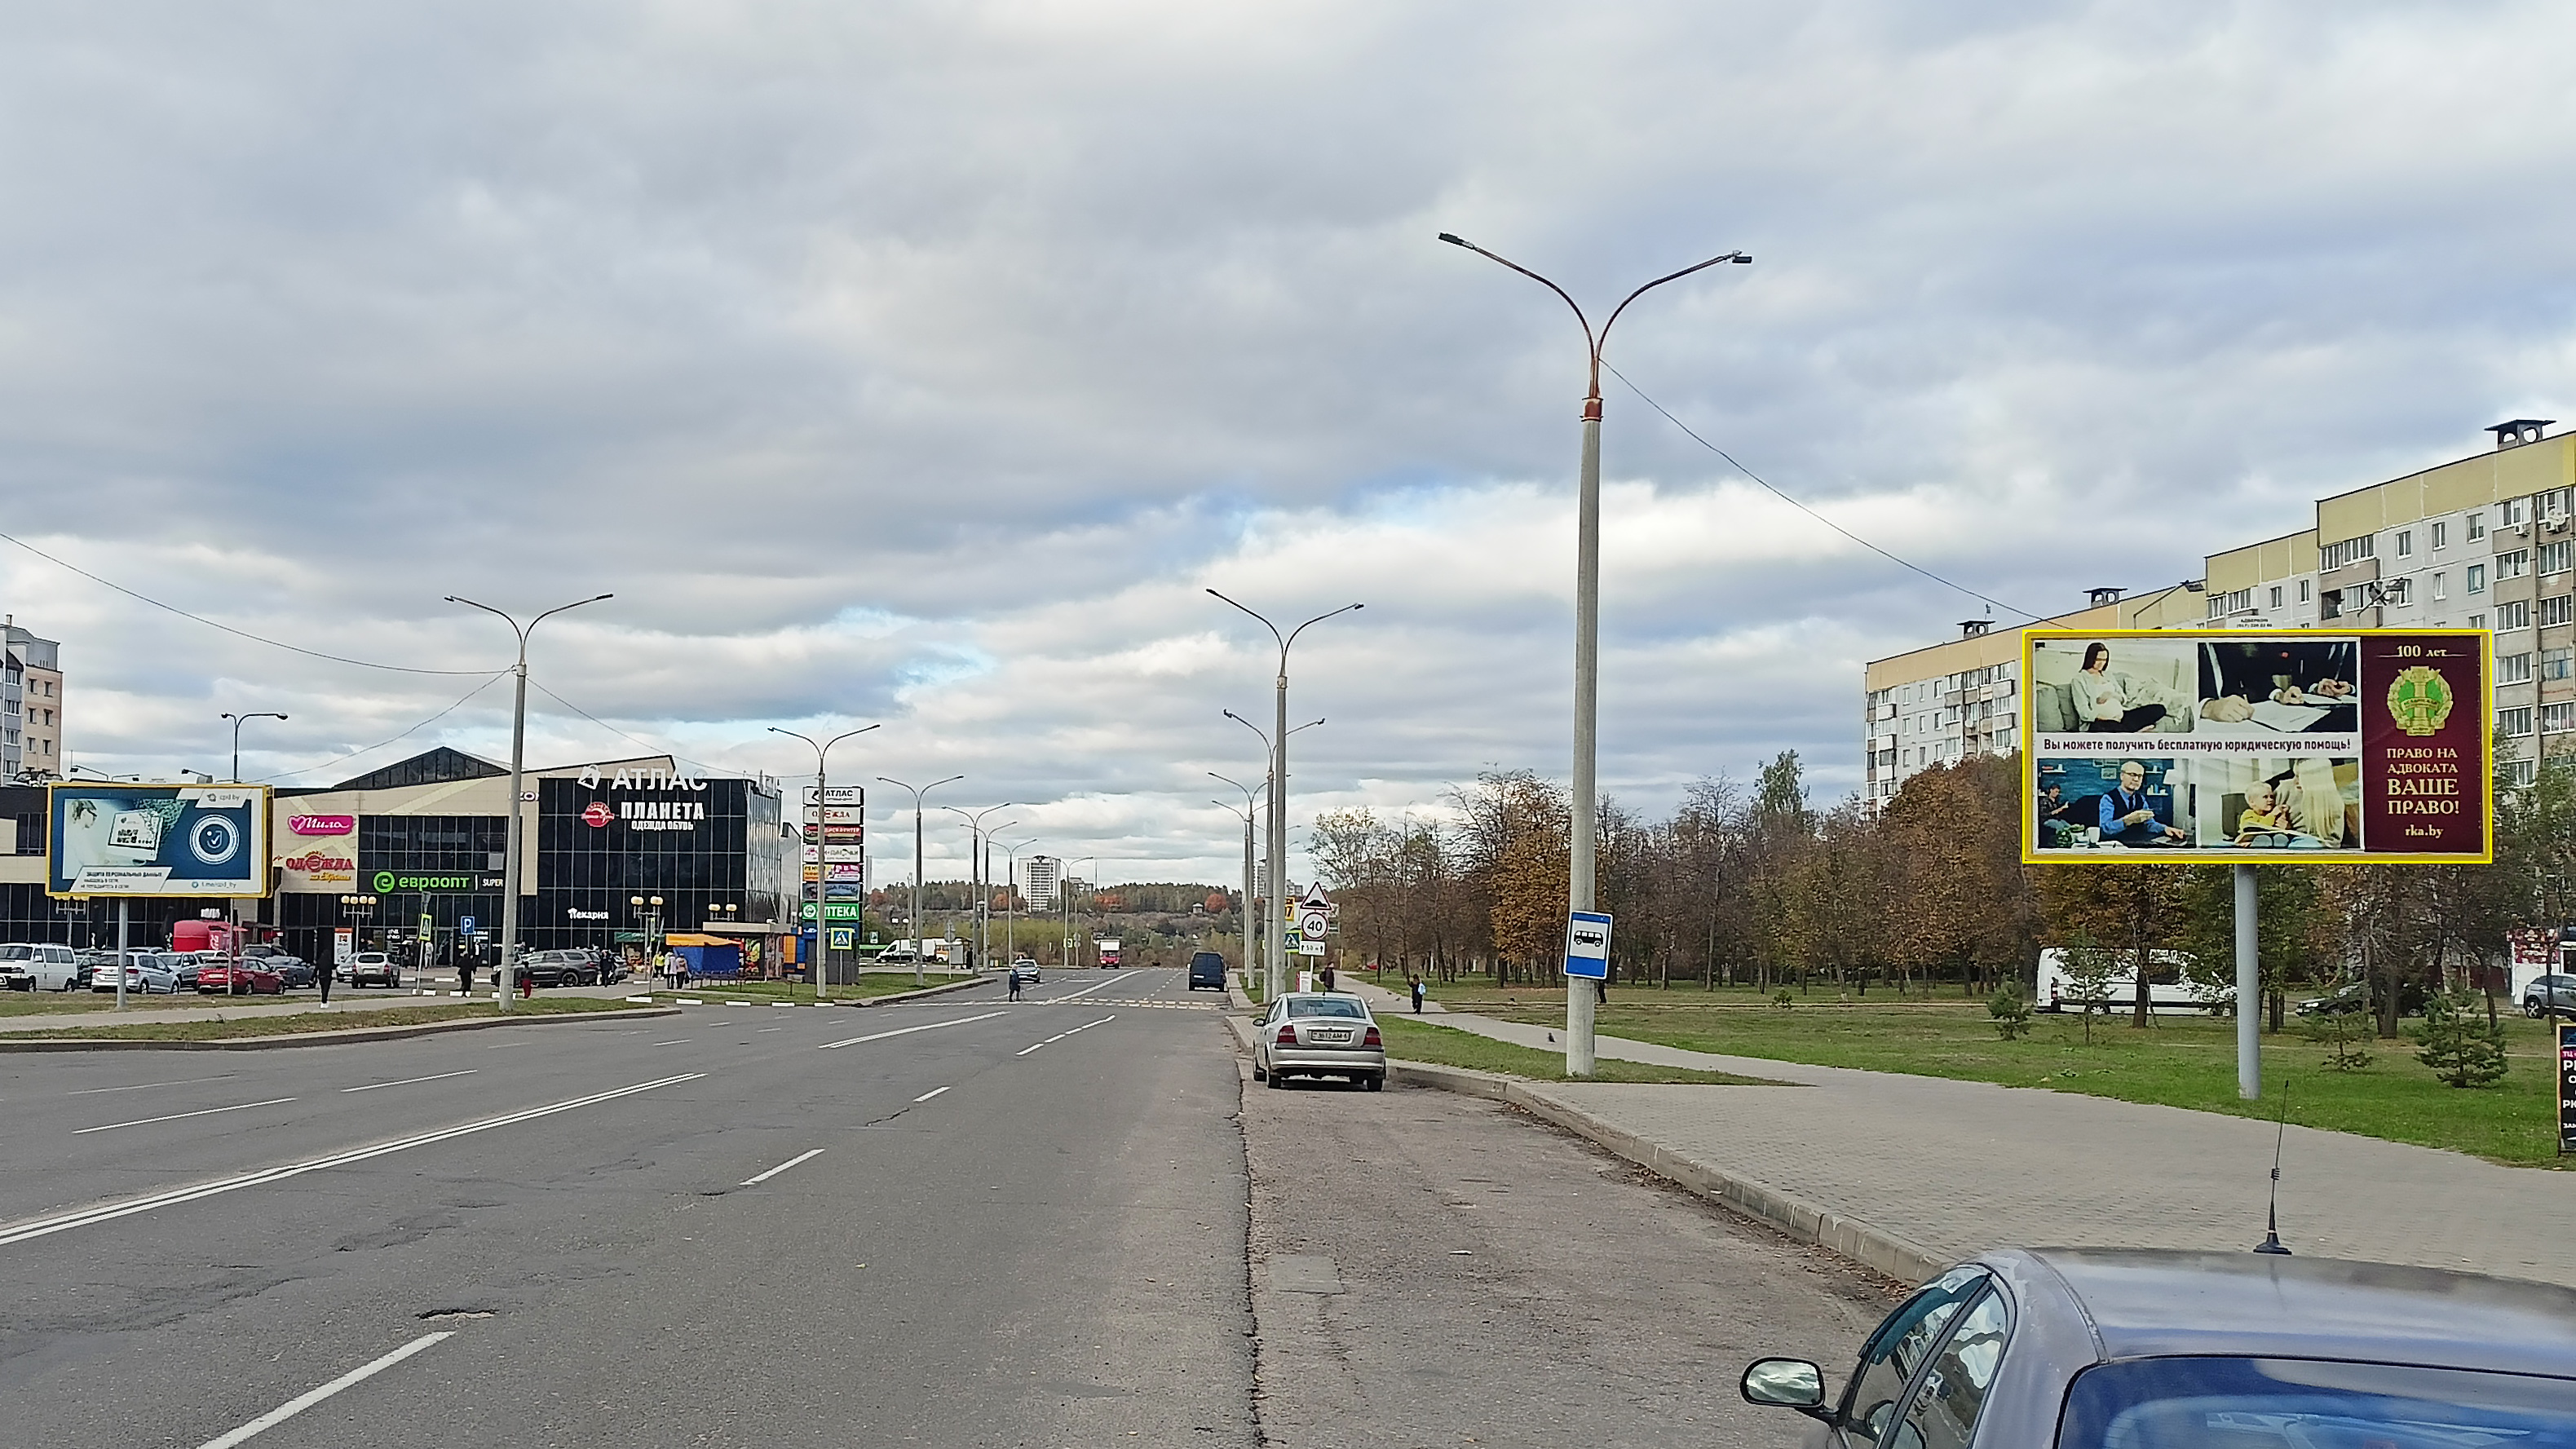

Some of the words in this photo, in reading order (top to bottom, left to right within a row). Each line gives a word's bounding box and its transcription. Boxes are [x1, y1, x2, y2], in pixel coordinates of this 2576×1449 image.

[2397, 645, 2421, 657] 100
[2426, 649, 2447, 657] лет
[2044, 739, 2061, 750] Вы
[2063, 740, 2103, 750] можете
[2106, 740, 2154, 752] получить
[2158, 739, 2222, 752] бесплатную
[2225, 740, 2301, 752] юридическую
[2304, 739, 2351, 751] помощь!
[2386, 748, 2433, 758] ПРАВО
[2437, 748, 2459, 758] НА
[2387, 763, 2459, 775] АДВОКАТА
[611, 767, 708, 791] АТЛАС
[2387, 778, 2459, 796] ВАШЕ
[621, 802, 705, 819] ПЛАНЕТА
[2388, 800, 2460, 815] ПРАВО!
[811, 809, 851, 819] ОЕЖДА
[631, 820, 667, 831] ОДЕЖДА
[667, 820, 694, 830] ОБУВЬ
[2405, 824, 2444, 839] rka.by
[286, 855, 356, 872] ОДЕЖДА
[399, 877, 470, 891] евроопт
[568, 908, 609, 920] Пекарня
[816, 906, 857, 917] ПТЕКА
[1307, 920, 1323, 932] 40
